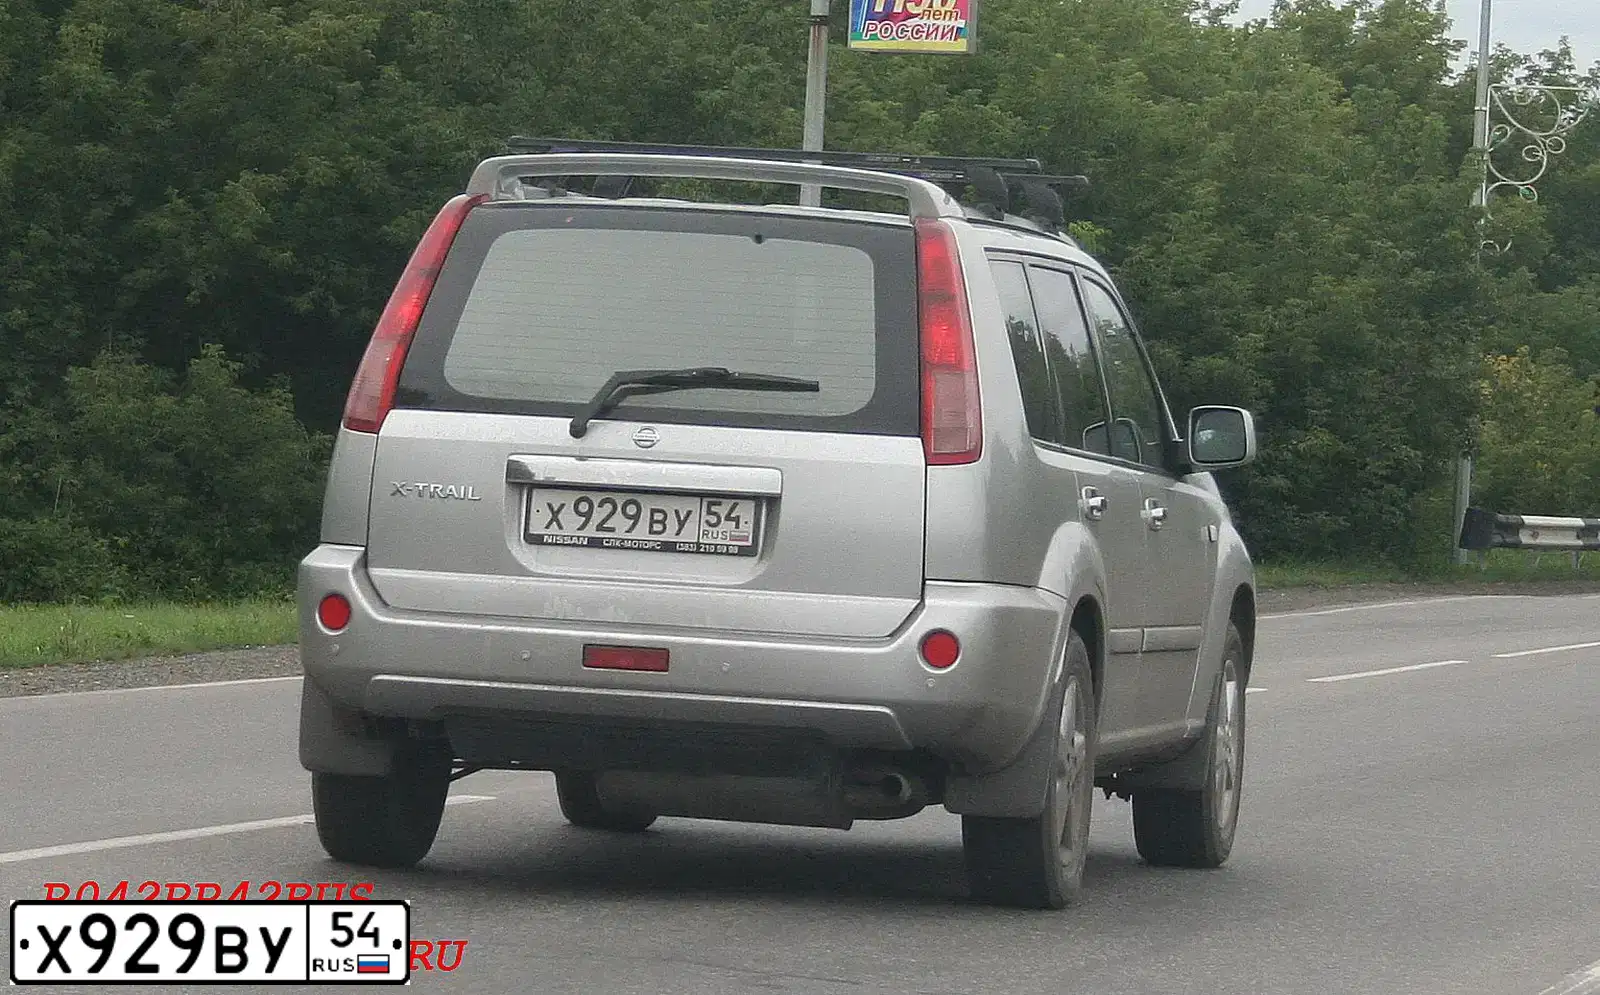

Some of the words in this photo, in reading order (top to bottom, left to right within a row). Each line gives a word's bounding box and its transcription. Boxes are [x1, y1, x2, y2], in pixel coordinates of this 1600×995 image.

[863, 21, 958, 41] РОССИИ
[391, 481, 481, 500] X-TRAIL
[704, 500, 741, 529] 54
[543, 534, 588, 545] NISSAN
[701, 529, 728, 541] RUS
